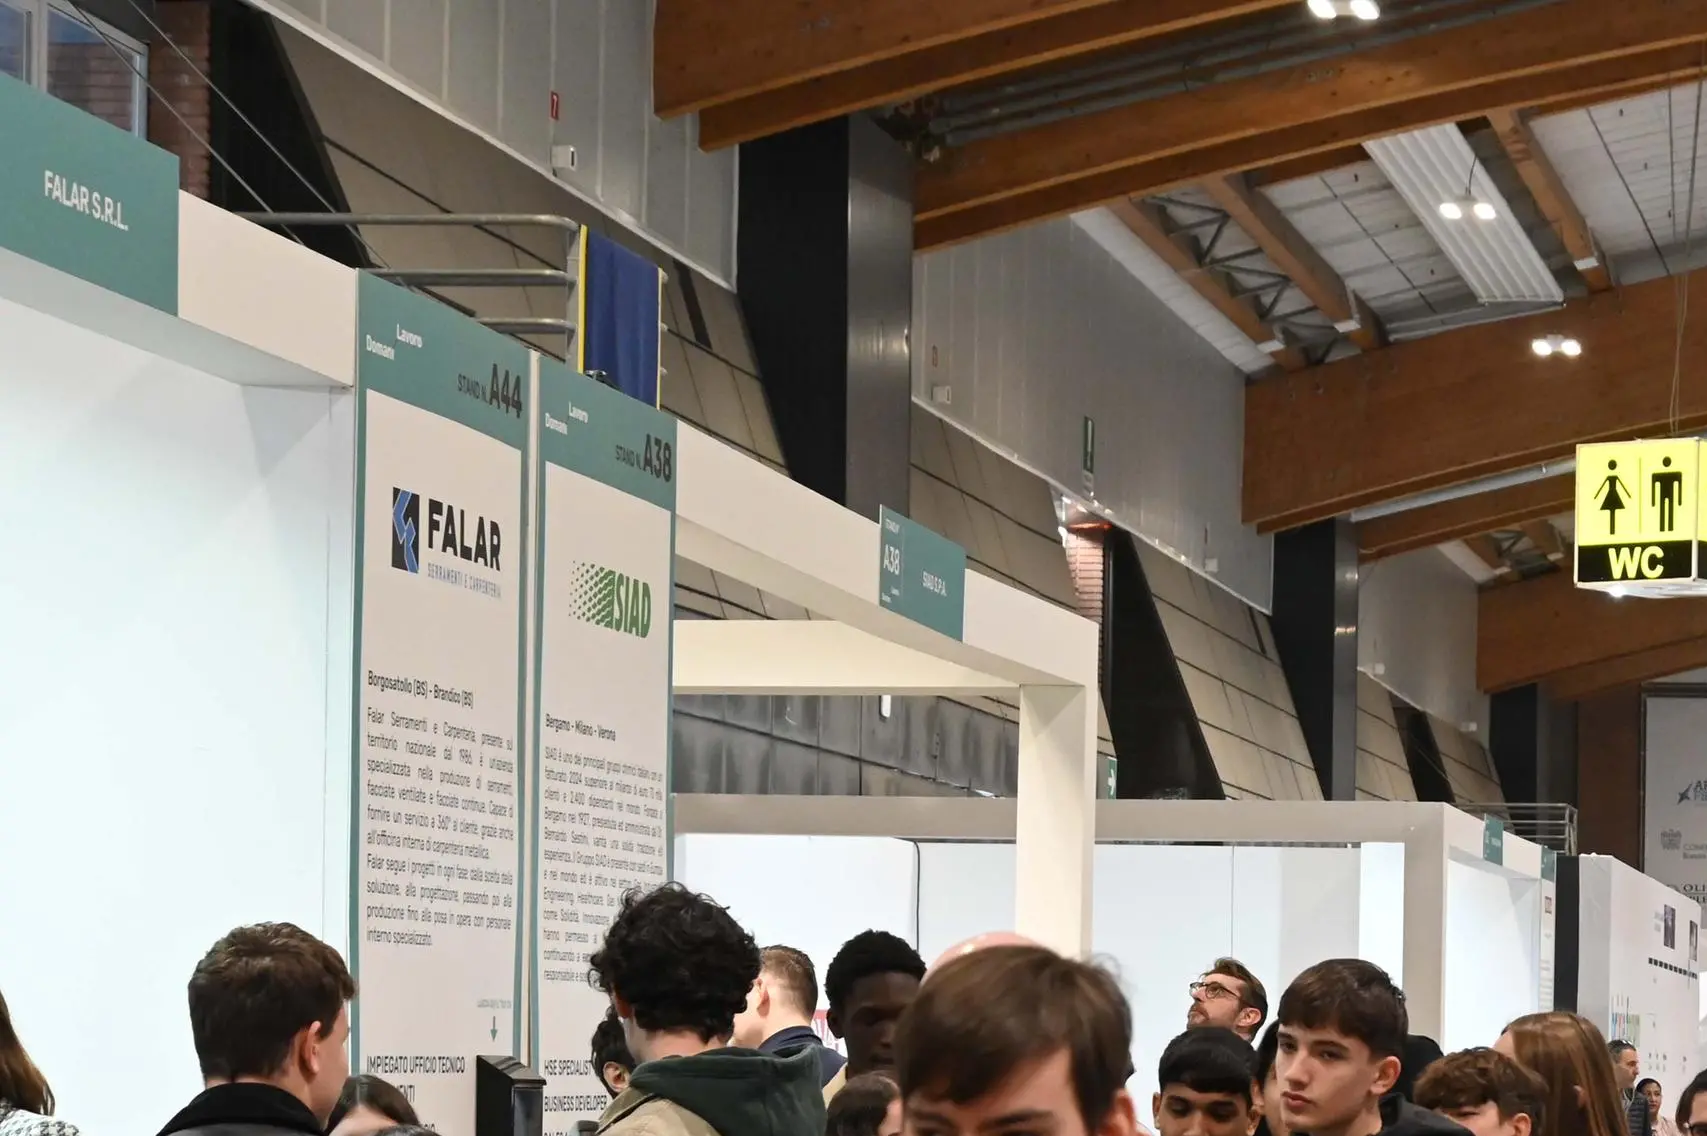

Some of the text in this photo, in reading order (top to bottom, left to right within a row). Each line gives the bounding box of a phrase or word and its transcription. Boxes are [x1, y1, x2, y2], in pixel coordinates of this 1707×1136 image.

[44, 170, 129, 231] FALAR S.R.L.
[396, 323, 423, 348] Lavoro
[458, 373, 480, 400] STAND
[489, 363, 523, 419] A44
[642, 433, 672, 482] A38
[428, 497, 502, 571] FALAR
[883, 544, 900, 575] A38
[1608, 545, 1664, 580] WC
[613, 570, 651, 638] SIAD
[368, 670, 412, 693] Borgosatollo
[413, 679, 428, 699] (BS)
[367, 733, 398, 751] territorio
[367, 758, 411, 777] specializzata
[367, 778, 395, 799] facciate
[367, 1055, 408, 1074] IMPIEGATO
[409, 1055, 437, 1074] UFFICIO
[545, 1060, 593, 1076] HSE SPECIALIST
[545, 1095, 607, 1112] BUSINESS DEVELOPER
